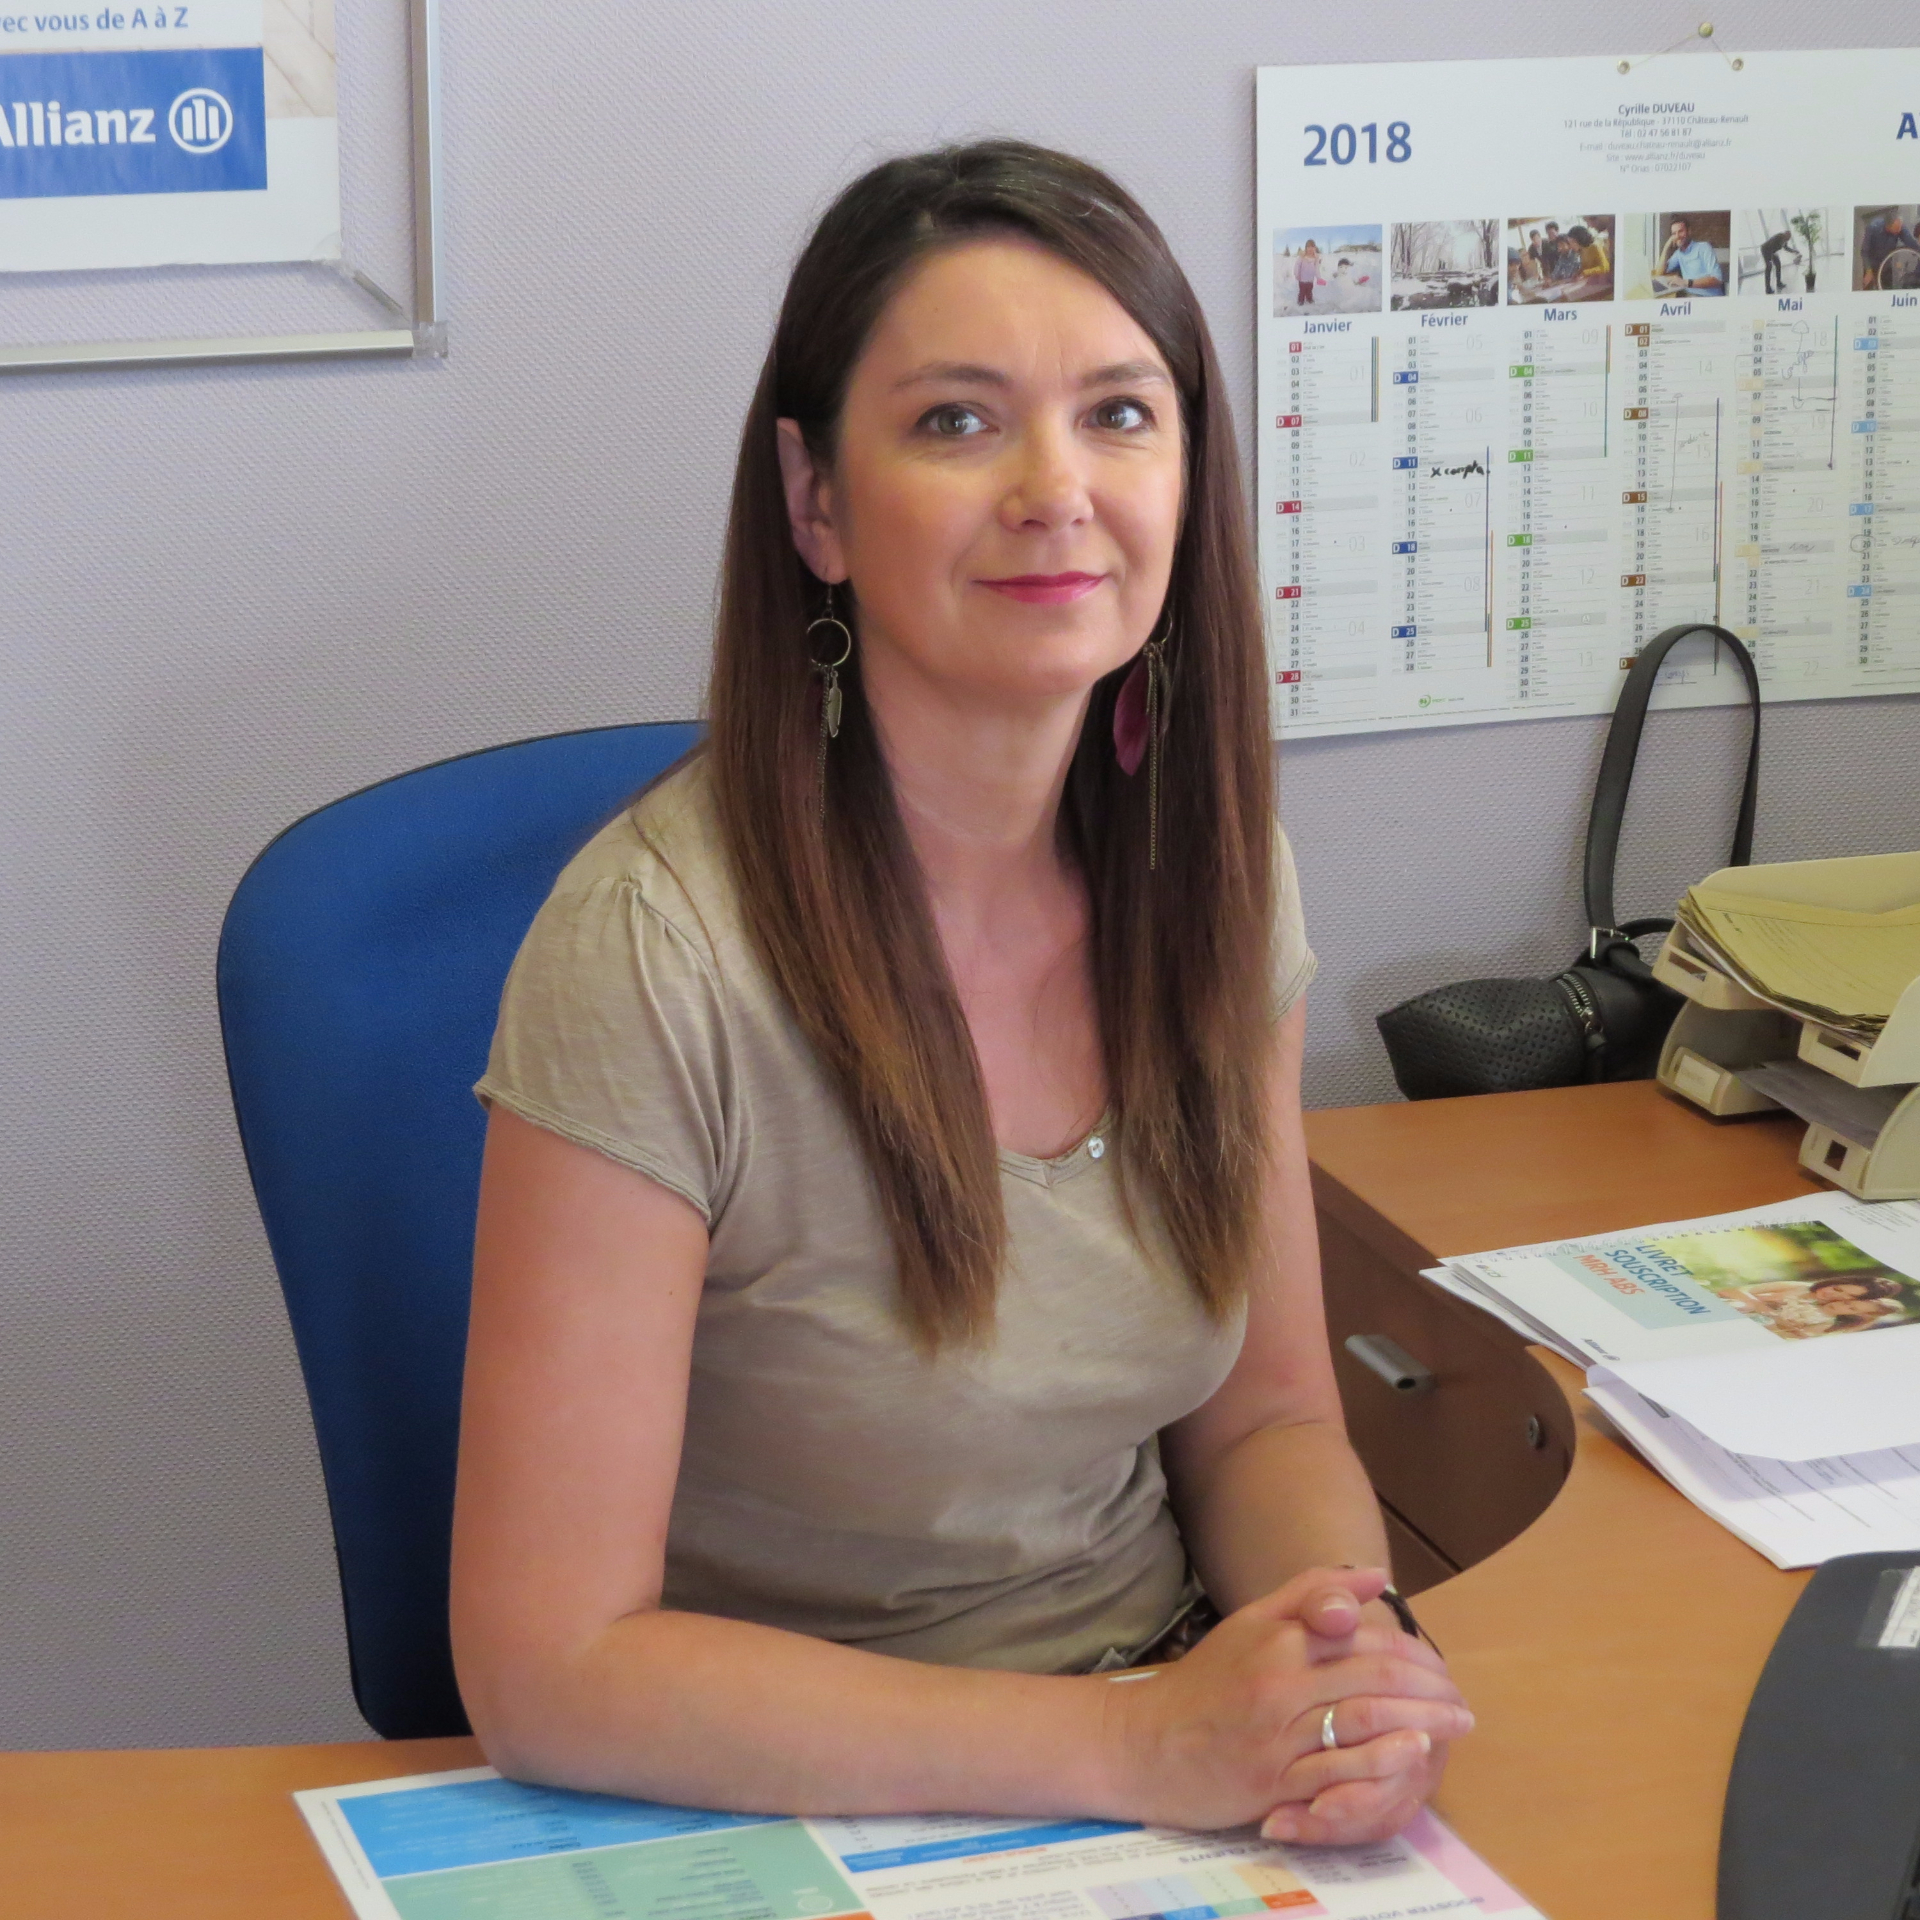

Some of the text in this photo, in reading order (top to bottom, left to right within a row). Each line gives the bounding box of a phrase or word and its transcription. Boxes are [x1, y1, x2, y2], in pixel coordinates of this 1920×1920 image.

[0, 5, 189, 33] ec vous de A à Z
[1618, 102, 1695, 116] Cyrille DUVEAU
[1564, 119, 1577, 128] 121
[1594, 118, 1603, 127] de
[1604, 118, 1611, 127] la
[1613, 117, 1655, 128] République
[1662, 115, 1685, 125] 37110
[1621, 128, 1632, 138] Tél
[1637, 128, 1647, 138] 02
[1649, 128, 1658, 137] 47
[1660, 128, 1670, 137] 56
[1671, 128, 1681, 137] 81
[1682, 127, 1692, 137] 87
[1303, 121, 1412, 166] 2018
[1778, 297, 1803, 312] Mai
[1891, 294, 1918, 308] Juin
[1660, 302, 1691, 317] Avril
[1543, 308, 1578, 321] Mars
[1421, 313, 1468, 327] Février
[1303, 320, 1352, 334] Janvier
[1626, 326, 1648, 334] D 01
[1524, 331, 1532, 339] 01
[1408, 336, 1417, 345] 01
[1639, 337, 1648, 346] 02
[1291, 343, 1300, 352] 01
[1523, 343, 1532, 351] 02
[1408, 348, 1417, 357] 02
[1291, 355, 1300, 364] 02
[1523, 355, 1532, 363] 03
[1408, 361, 1417, 369] 03
[1291, 367, 1300, 376] 03
[1510, 368, 1517, 376] D
[1394, 373, 1417, 382] D 04
[1291, 380, 1300, 388] 04
[1523, 379, 1532, 387] 05
[1407, 385, 1417, 393] 05
[1291, 392, 1300, 401] 05
[1291, 404, 1300, 413] 06
[1523, 403, 1532, 411] 07
[1407, 409, 1416, 418] 07
[1624, 410, 1631, 418] D
[1276, 416, 1300, 426] D 07
[1523, 415, 1532, 423] 08
[1407, 421, 1416, 430] 08
[1291, 429, 1300, 438] 08
[1522, 427, 1531, 435] 09
[1407, 434, 1416, 442] 09
[1291, 441, 1300, 450] 09
[1522, 439, 1531, 447] 10
[1407, 446, 1416, 454] 10
[1290, 453, 1300, 462] 10
[1509, 451, 1531, 460] D 11
[1393, 458, 1416, 467] D 11
[1290, 465, 1300, 474] 11
[1407, 470, 1416, 478] 12
[1290, 478, 1300, 486] 12
[1407, 482, 1416, 490] 13
[1290, 490, 1300, 499] 13
[1407, 494, 1416, 503] 14
[1623, 493, 1645, 502] D 15
[1276, 502, 1300, 511] D 14
[1406, 506, 1416, 515] 15
[1290, 514, 1300, 523] 15
[1406, 518, 1416, 527] 16
[1290, 526, 1300, 535] 16
[1406, 530, 1416, 539] 17
[1290, 539, 1300, 547] 17
[1508, 537, 1515, 545] D
[1393, 543, 1416, 552] D 18
[1290, 551, 1300, 560] 18
[1406, 555, 1416, 563] 19
[1290, 563, 1300, 572] 19
[1406, 567, 1416, 575] 20
[1290, 575, 1300, 584] 20
[1406, 579, 1416, 587] 21
[1622, 577, 1629, 585] D
[1276, 587, 1300, 597] D 21
[1406, 591, 1416, 599] 22
[1290, 599, 1300, 608] 22
[1406, 603, 1415, 611] 23
[1290, 612, 1300, 620] 23
[1406, 615, 1415, 623] 24
[1290, 624, 1300, 632] 24
[1507, 620, 1514, 628] D
[1392, 627, 1415, 636] D 25
[1290, 636, 1300, 644] 25
[1405, 639, 1415, 647] 26
[1405, 651, 1415, 659] 27
[1290, 660, 1299, 668] 27
[1405, 663, 1415, 671] 28
[1276, 672, 1299, 682] D 28
[1290, 684, 1299, 692] 29
[1290, 696, 1299, 704] 30
[1290, 708, 1299, 717] 31
[1634, 1244, 1695, 1277] LIVRET
[1573, 1254, 1646, 1295] MRH ABS
[1604, 1249, 1712, 1315] SOUSCRIPTION
